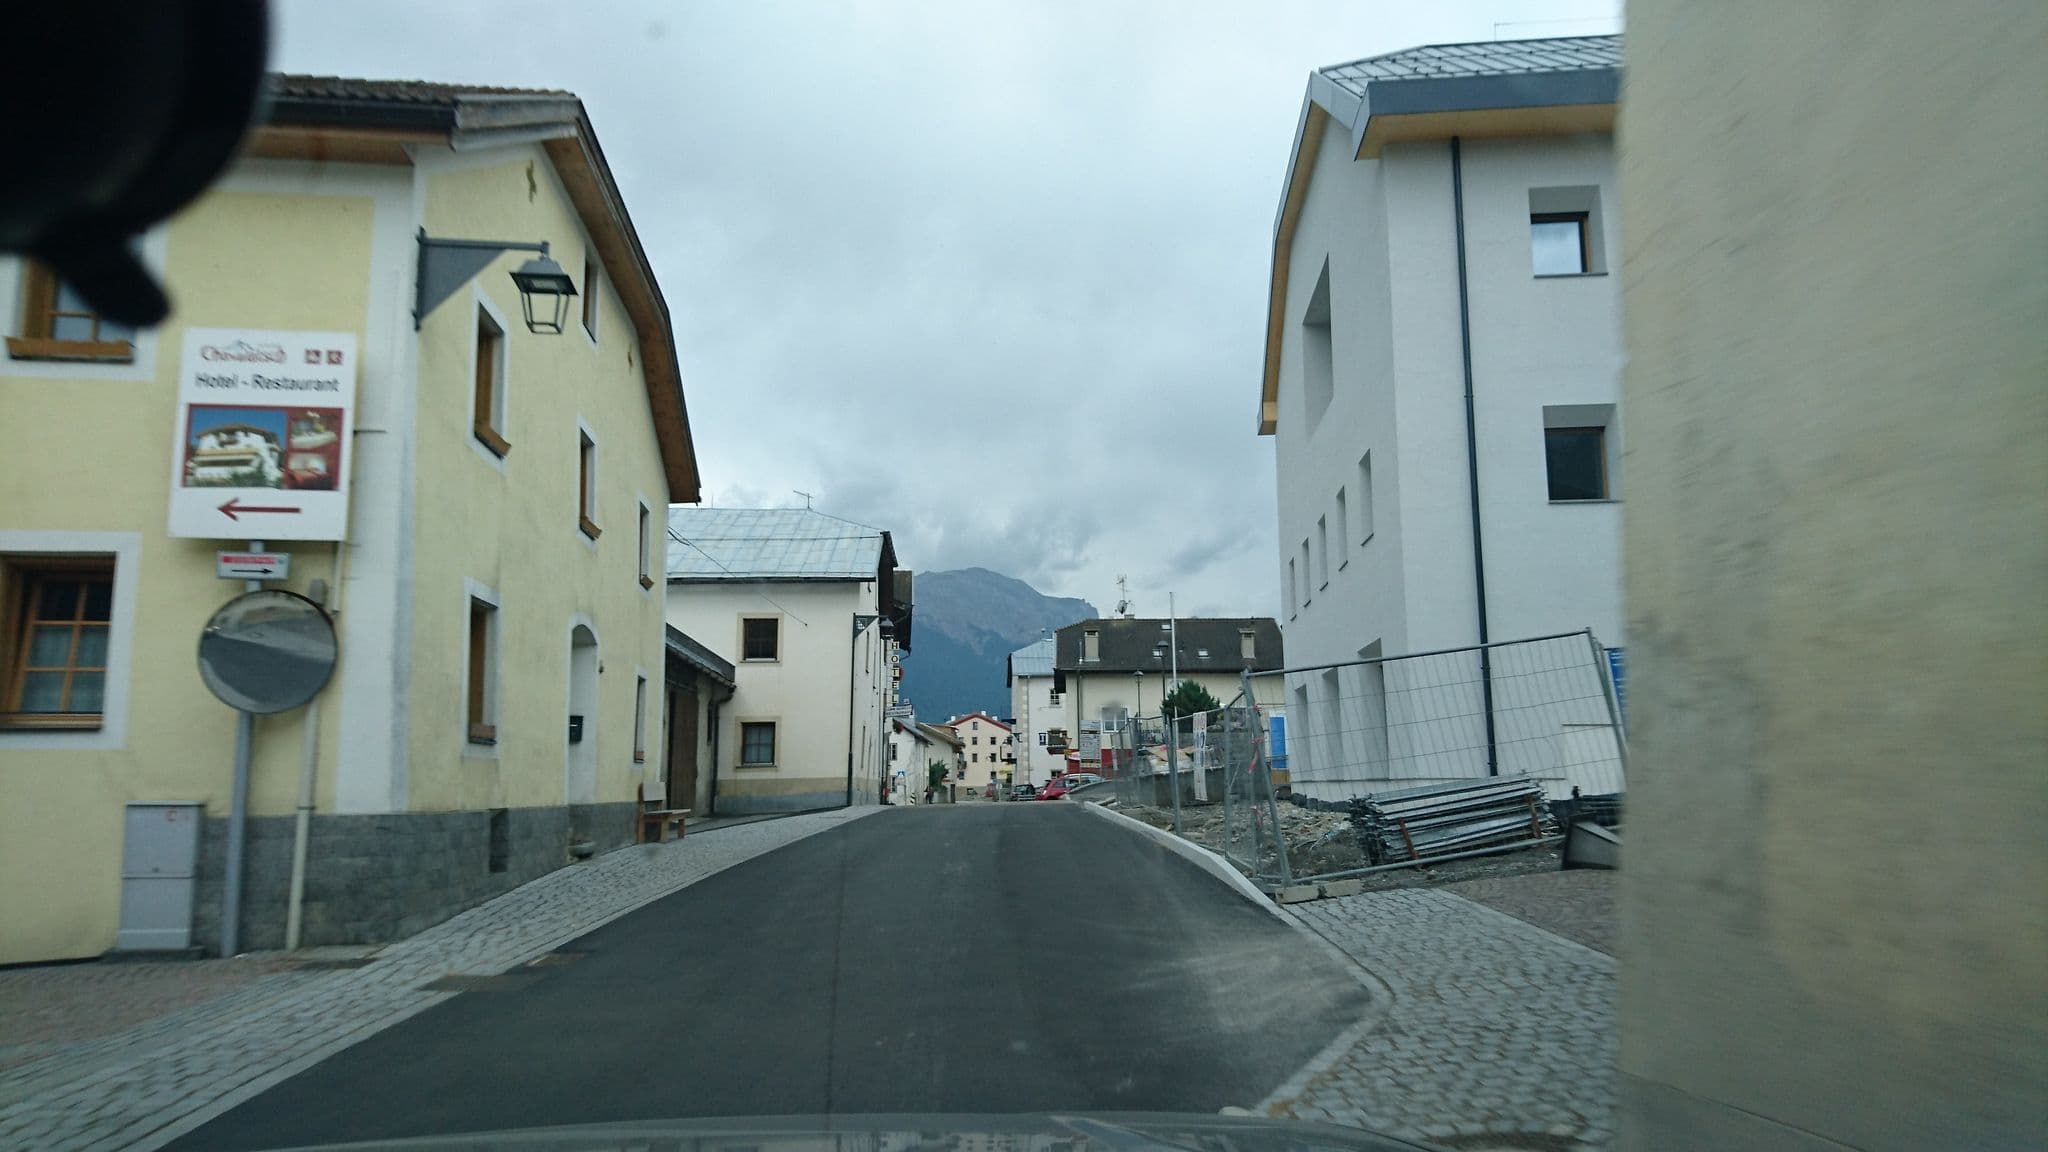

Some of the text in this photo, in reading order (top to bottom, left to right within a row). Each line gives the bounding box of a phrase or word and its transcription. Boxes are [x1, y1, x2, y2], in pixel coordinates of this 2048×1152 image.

[196, 373, 238, 389] Hotel
[252, 374, 340, 392] Restaurant
[891, 642, 899, 703] HOTEL
